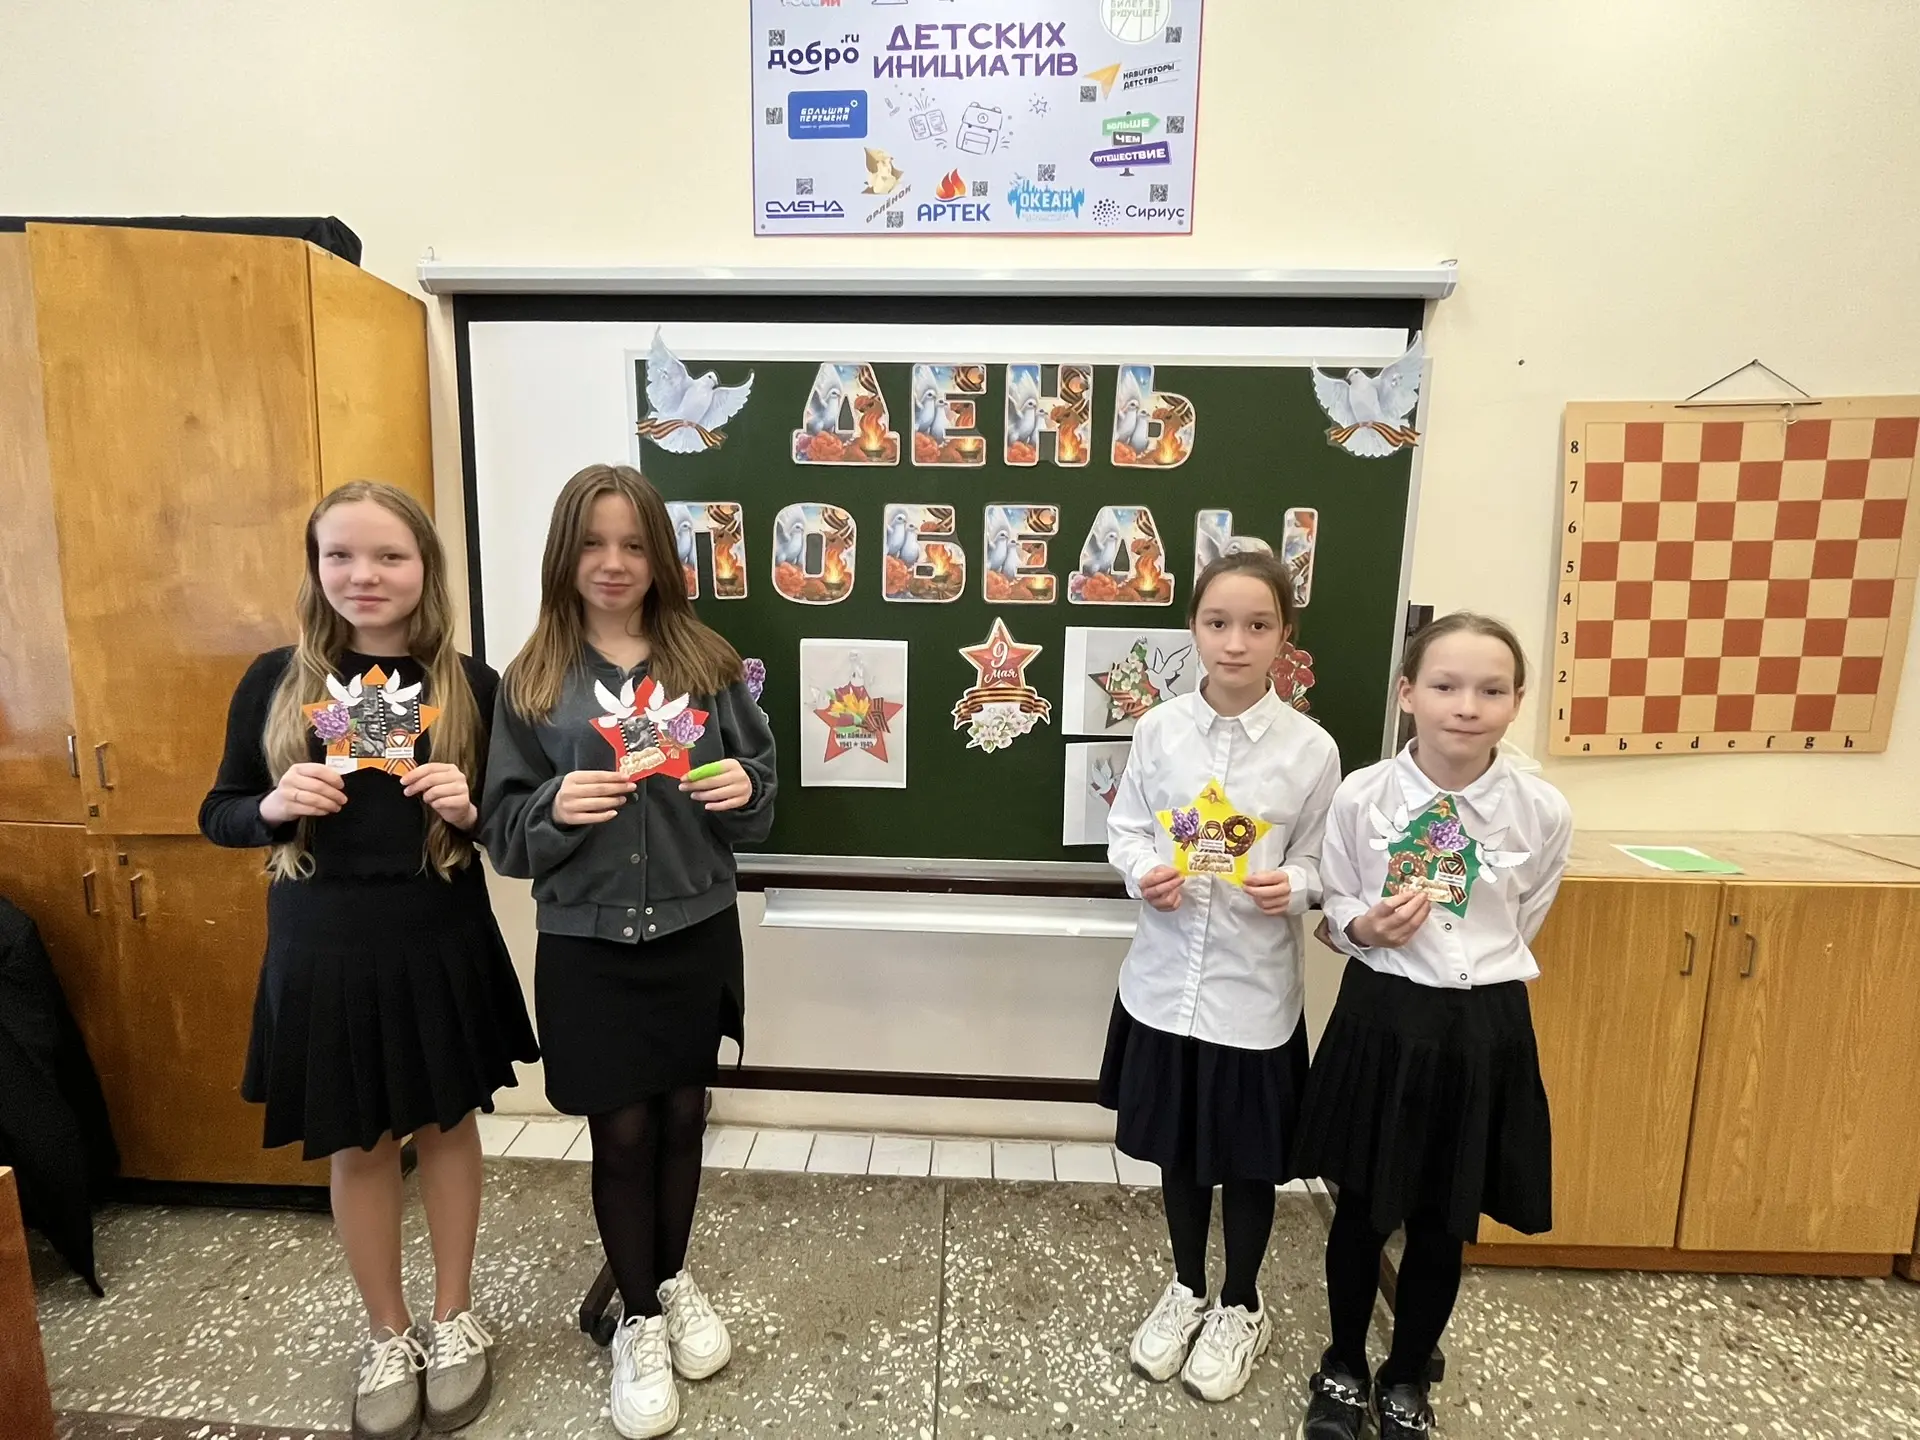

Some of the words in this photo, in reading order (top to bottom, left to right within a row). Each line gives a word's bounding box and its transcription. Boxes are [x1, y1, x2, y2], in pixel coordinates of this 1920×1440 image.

[886, 21, 1066, 51] ДЕТСКИХ
[767, 40, 860, 71] добро
[873, 53, 1079, 80] ИНИЦИАТИВ
[1123, 62, 1175, 80] НАВИГАТОРЫ
[1123, 76, 1159, 90] ДЕТСТВА
[799, 114, 849, 123] ПЕРЕМЕНА
[800, 107, 851, 116] БОЛЬШАЯ
[1106, 118, 1150, 130] БОЛЬШЕ
[1115, 134, 1141, 144] ЧЕМ
[1093, 148, 1167, 163] ПУТЕШЕСТВИЕ
[1019, 192, 1073, 208] ОКЕАН
[917, 203, 991, 222] АРТЕК
[1125, 204, 1185, 221] Сириус
[791, 361, 1196, 469] ДЕНЬ
[1570, 440, 1579, 454] 8
[1570, 480, 1578, 494] 7
[1568, 520, 1577, 534] 6
[1565, 560, 1574, 574] 5
[1563, 592, 1572, 606] 4
[1560, 631, 1569, 645] 3
[990, 640, 1009, 669] 9
[1557, 670, 1567, 683] 2
[1558, 708, 1564, 721] 1
[1582, 742, 1591, 752] a
[1618, 737, 1628, 751] b
[1655, 741, 1663, 750] c
[1690, 736, 1700, 749] d
[1727, 739, 1736, 748] e
[1766, 735, 1776, 749] f
[1804, 736, 1815, 750] g
[1843, 735, 1854, 749] h
